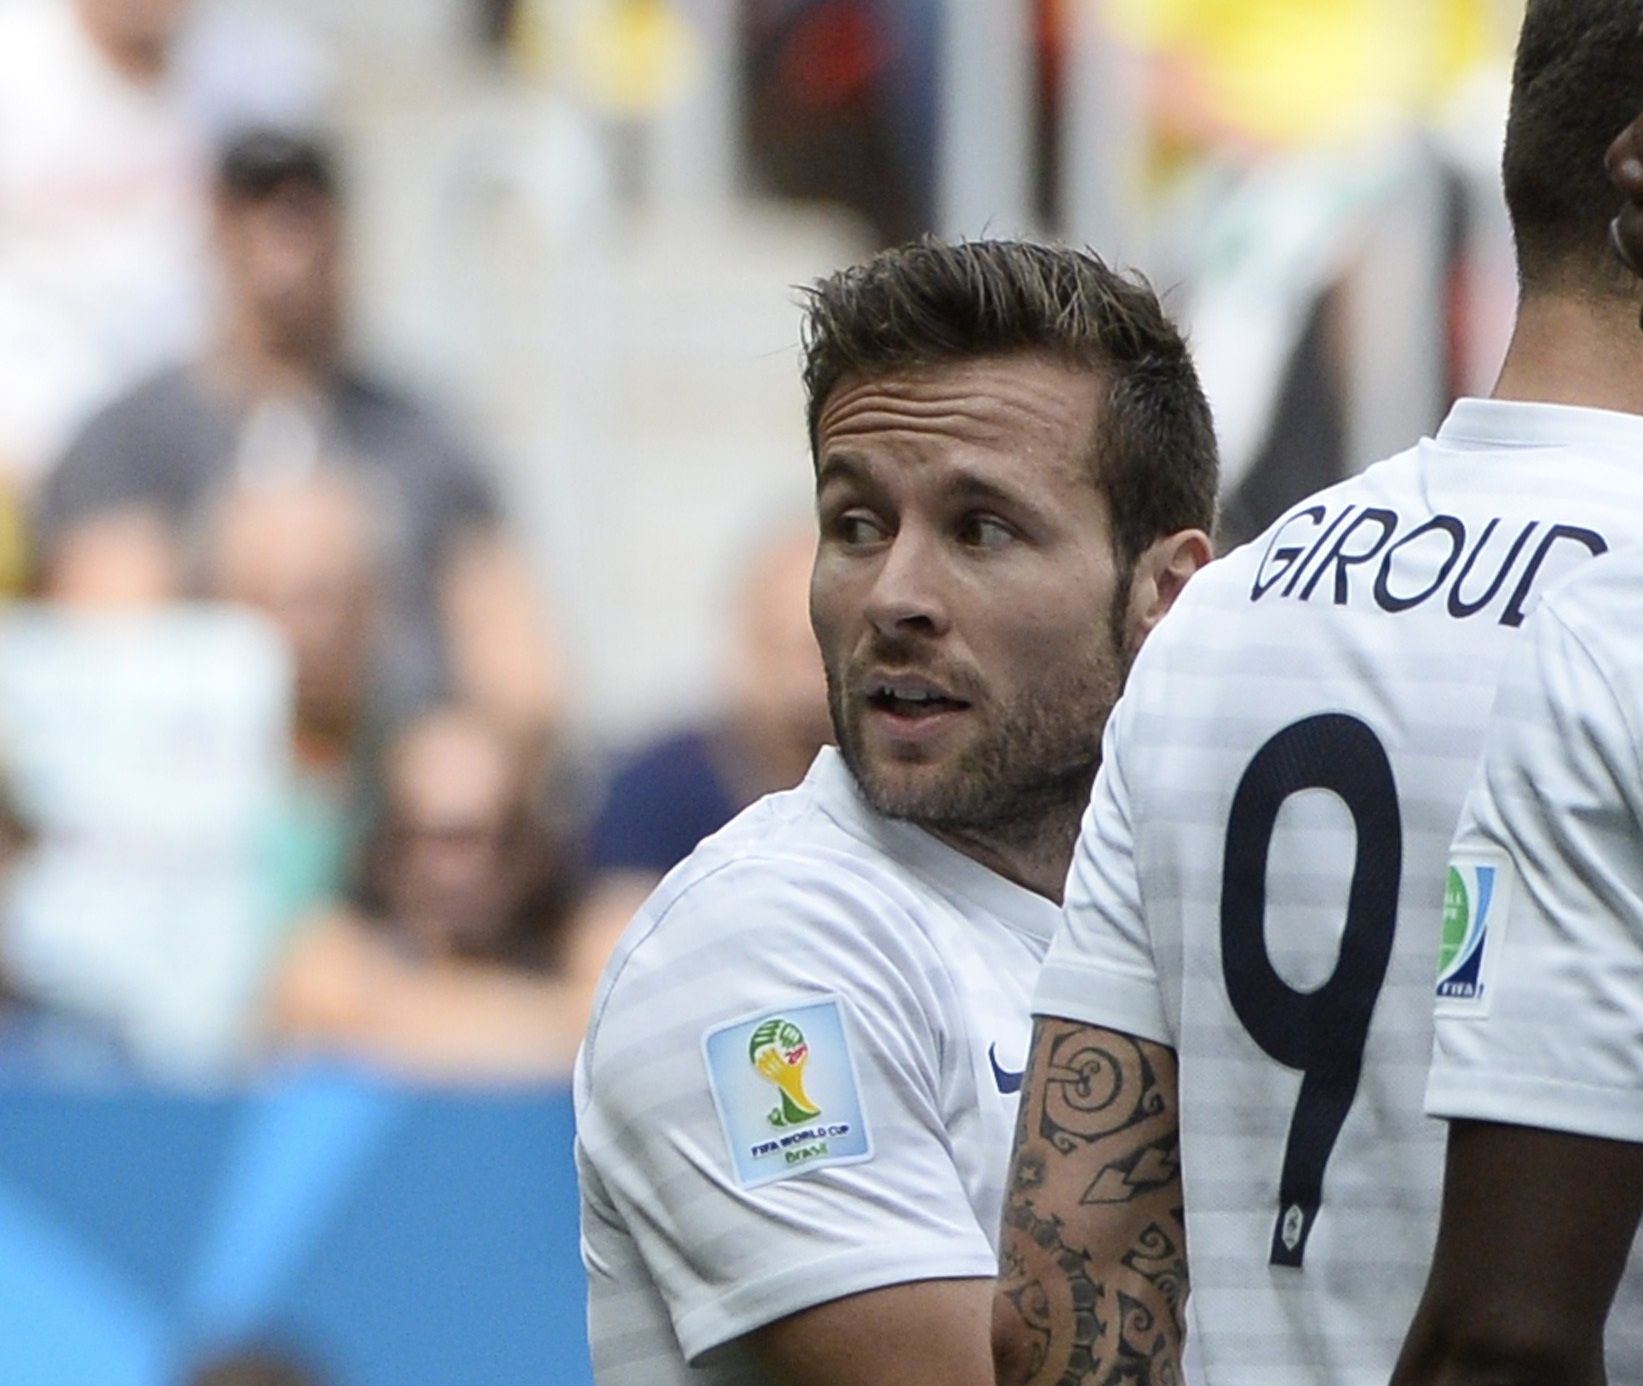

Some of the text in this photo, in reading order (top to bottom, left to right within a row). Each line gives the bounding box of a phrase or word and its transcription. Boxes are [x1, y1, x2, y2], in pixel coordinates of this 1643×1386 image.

[1221, 714, 1402, 1268] 9
[751, 1124, 850, 1158] FIFA WORLD CUP
